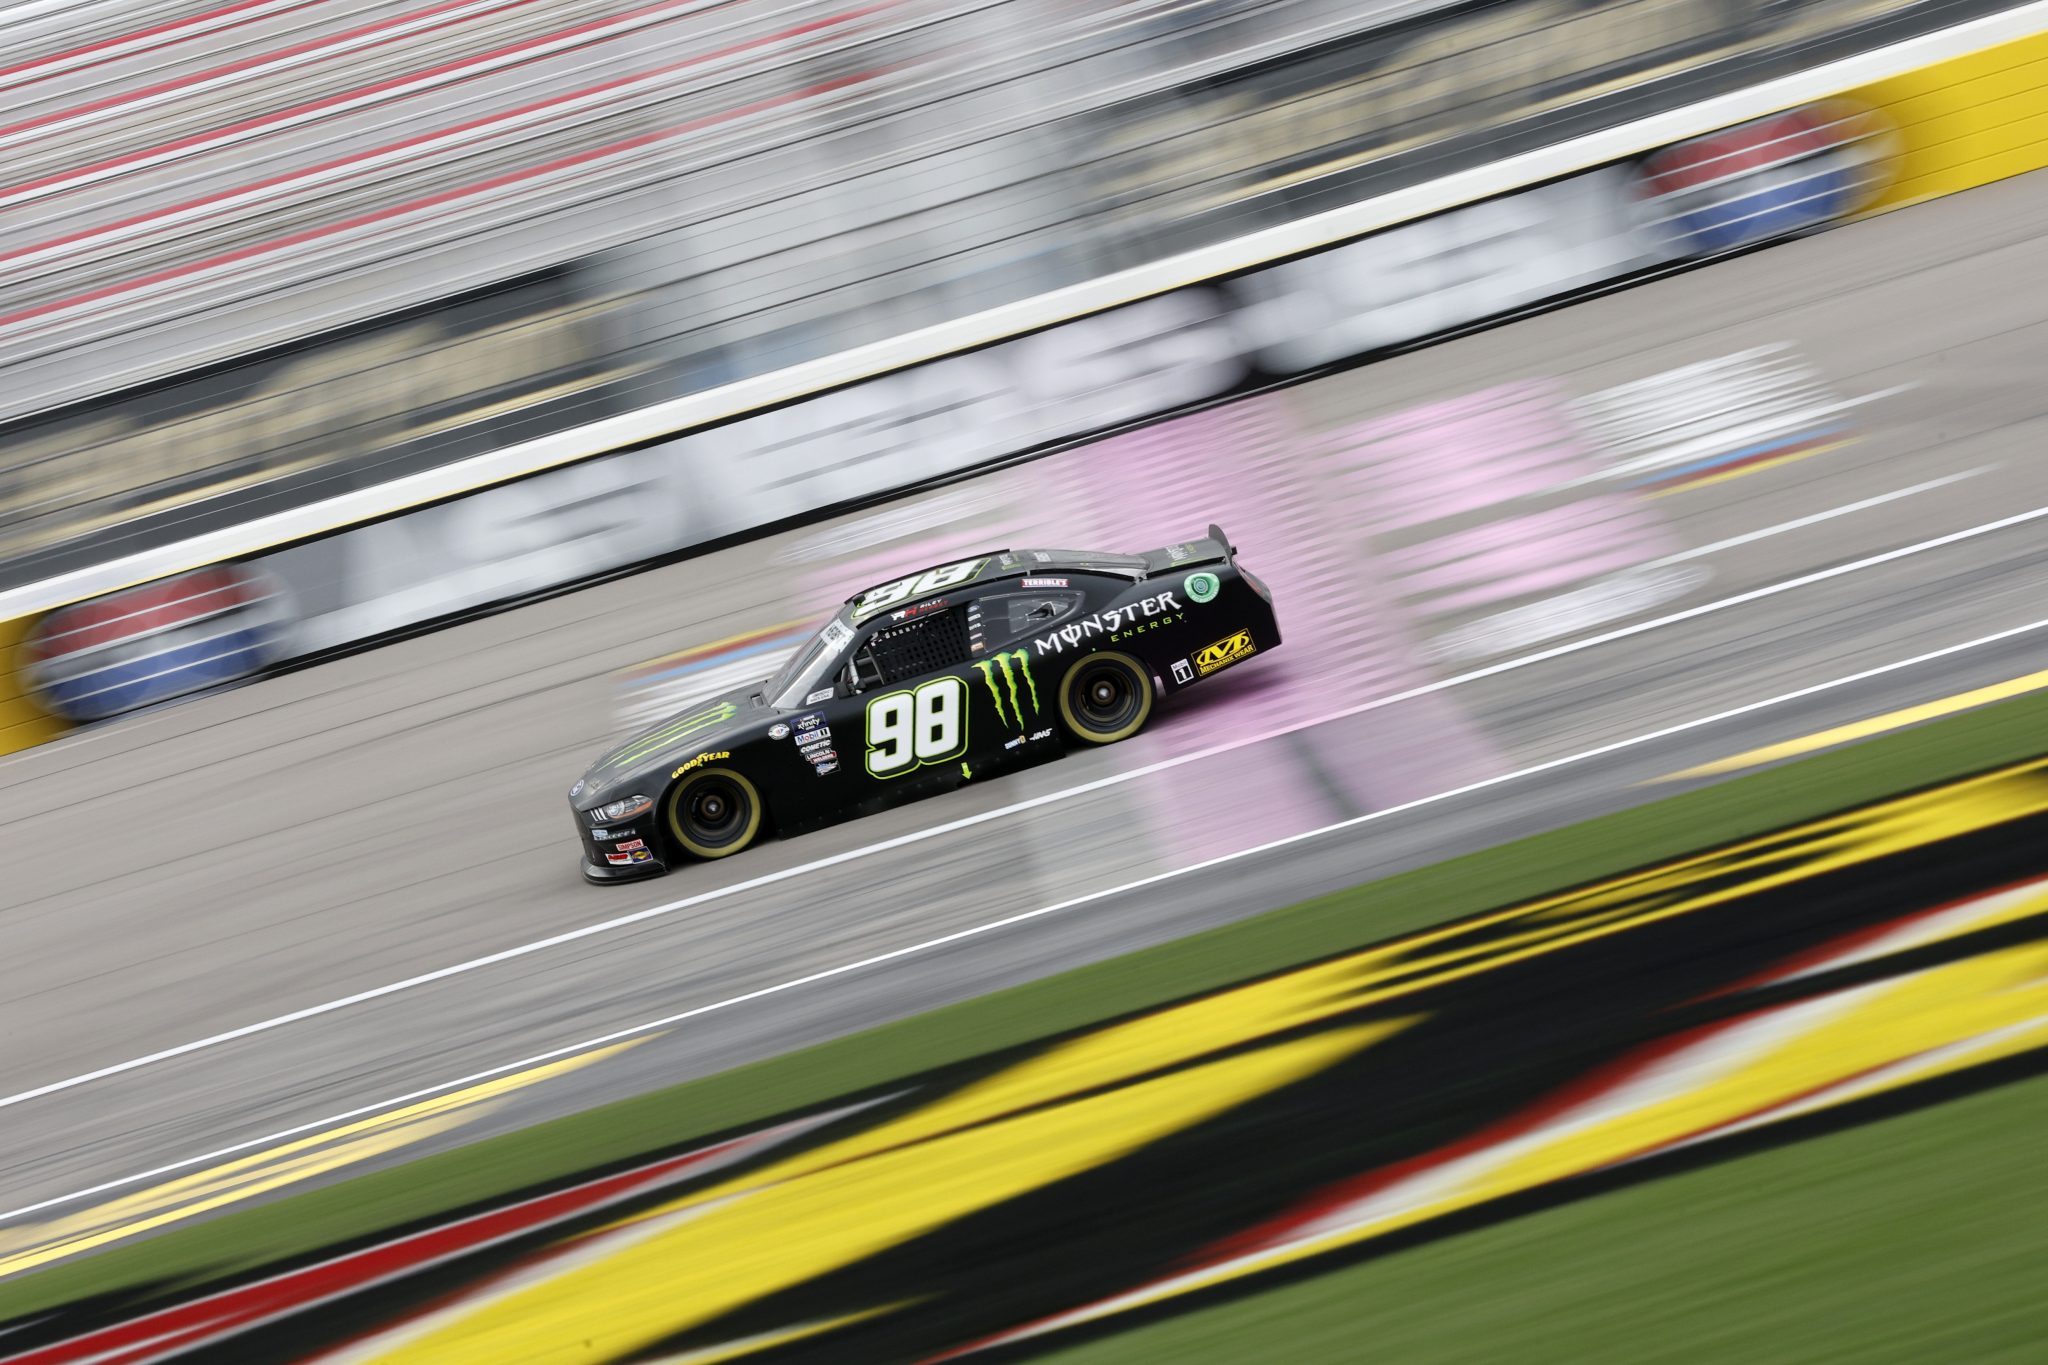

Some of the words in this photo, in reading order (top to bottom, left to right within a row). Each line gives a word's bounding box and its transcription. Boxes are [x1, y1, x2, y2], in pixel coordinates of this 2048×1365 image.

[853, 558, 986, 618] 98
[1034, 591, 1182, 656] MONSTER
[1110, 612, 1185, 643] ENERGY
[1200, 655, 1234, 675] MECHANIX
[1234, 644, 1255, 660] WEAR
[1178, 668, 1188, 680] 1
[797, 731, 819, 743] Mobil
[867, 678, 966, 776] 98
[800, 739, 832, 754] COMETIC
[806, 748, 832, 760] LINCOLN
[671, 751, 731, 779] GOODYEAR
[617, 840, 643, 850] SIMPSON
